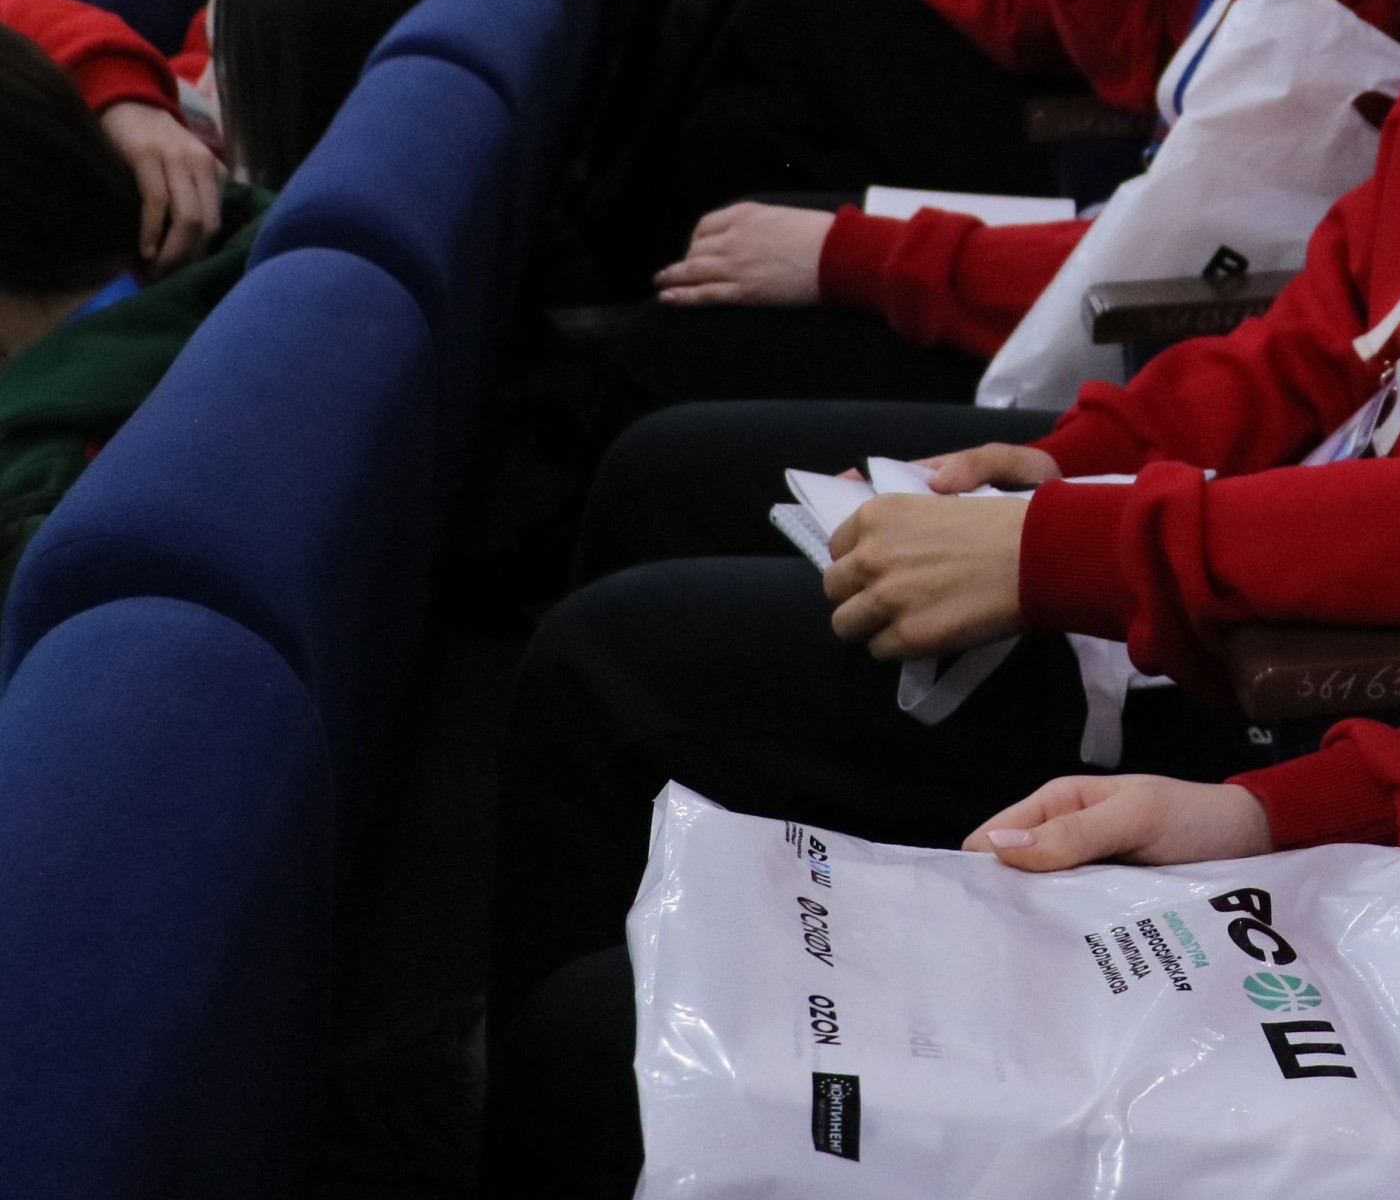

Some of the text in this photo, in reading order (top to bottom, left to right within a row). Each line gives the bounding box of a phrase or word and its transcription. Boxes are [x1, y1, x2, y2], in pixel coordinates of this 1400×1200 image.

[1084, 933, 1129, 996] ШКОЛЬНИКОВ
[1111, 926, 1152, 981] ОЛИМПИАДА
[1136, 918, 1192, 992] ВСЕРОССИЙСКАЯ
[808, 994, 841, 1046] OZON
[829, 1082, 843, 1154] КОНТИНЕНТ
